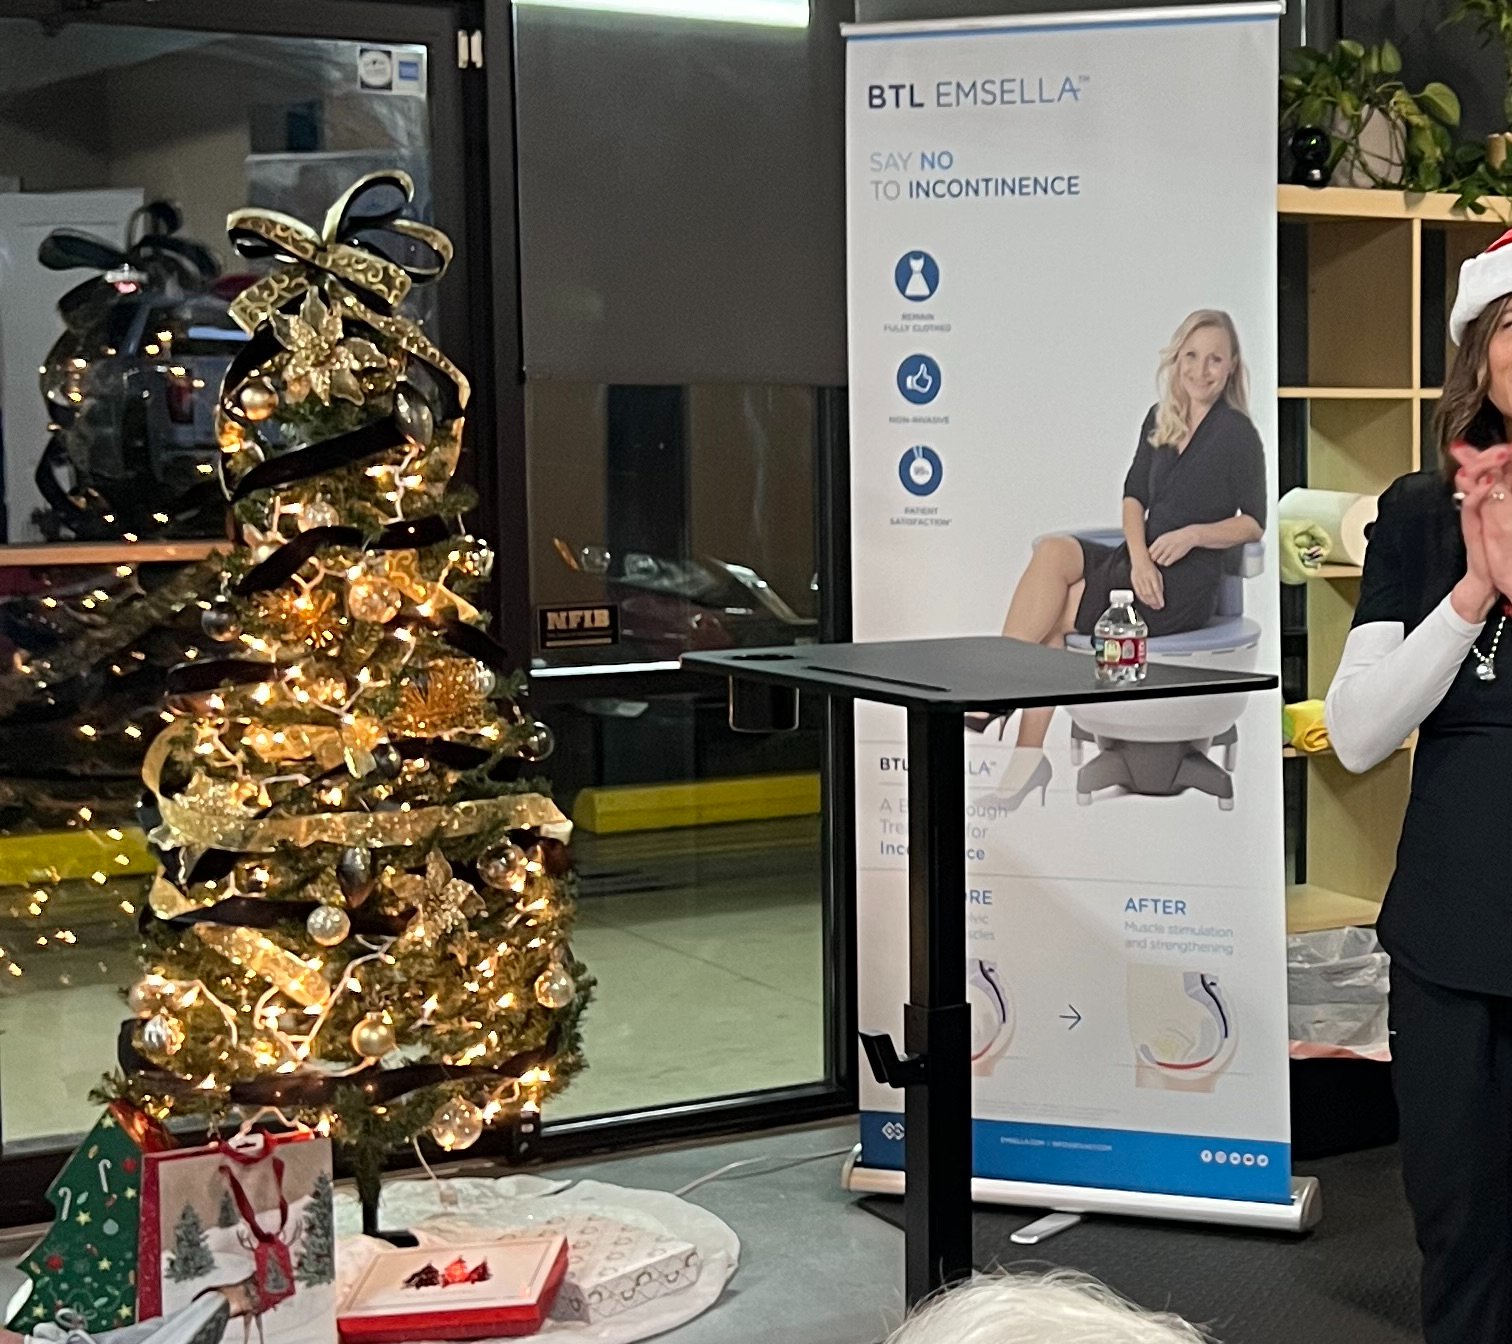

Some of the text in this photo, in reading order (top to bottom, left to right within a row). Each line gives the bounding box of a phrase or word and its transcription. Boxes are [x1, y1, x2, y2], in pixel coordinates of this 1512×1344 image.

[868, 84, 925, 109] BTL
[870, 150, 953, 172] SAY NO
[871, 175, 1080, 201] TO INCONTINENCE
[1124, 897, 1187, 915] AFTER
[1124, 921, 1234, 938] Muscle stimulation
[1150, 939, 1234, 956] strengthening
